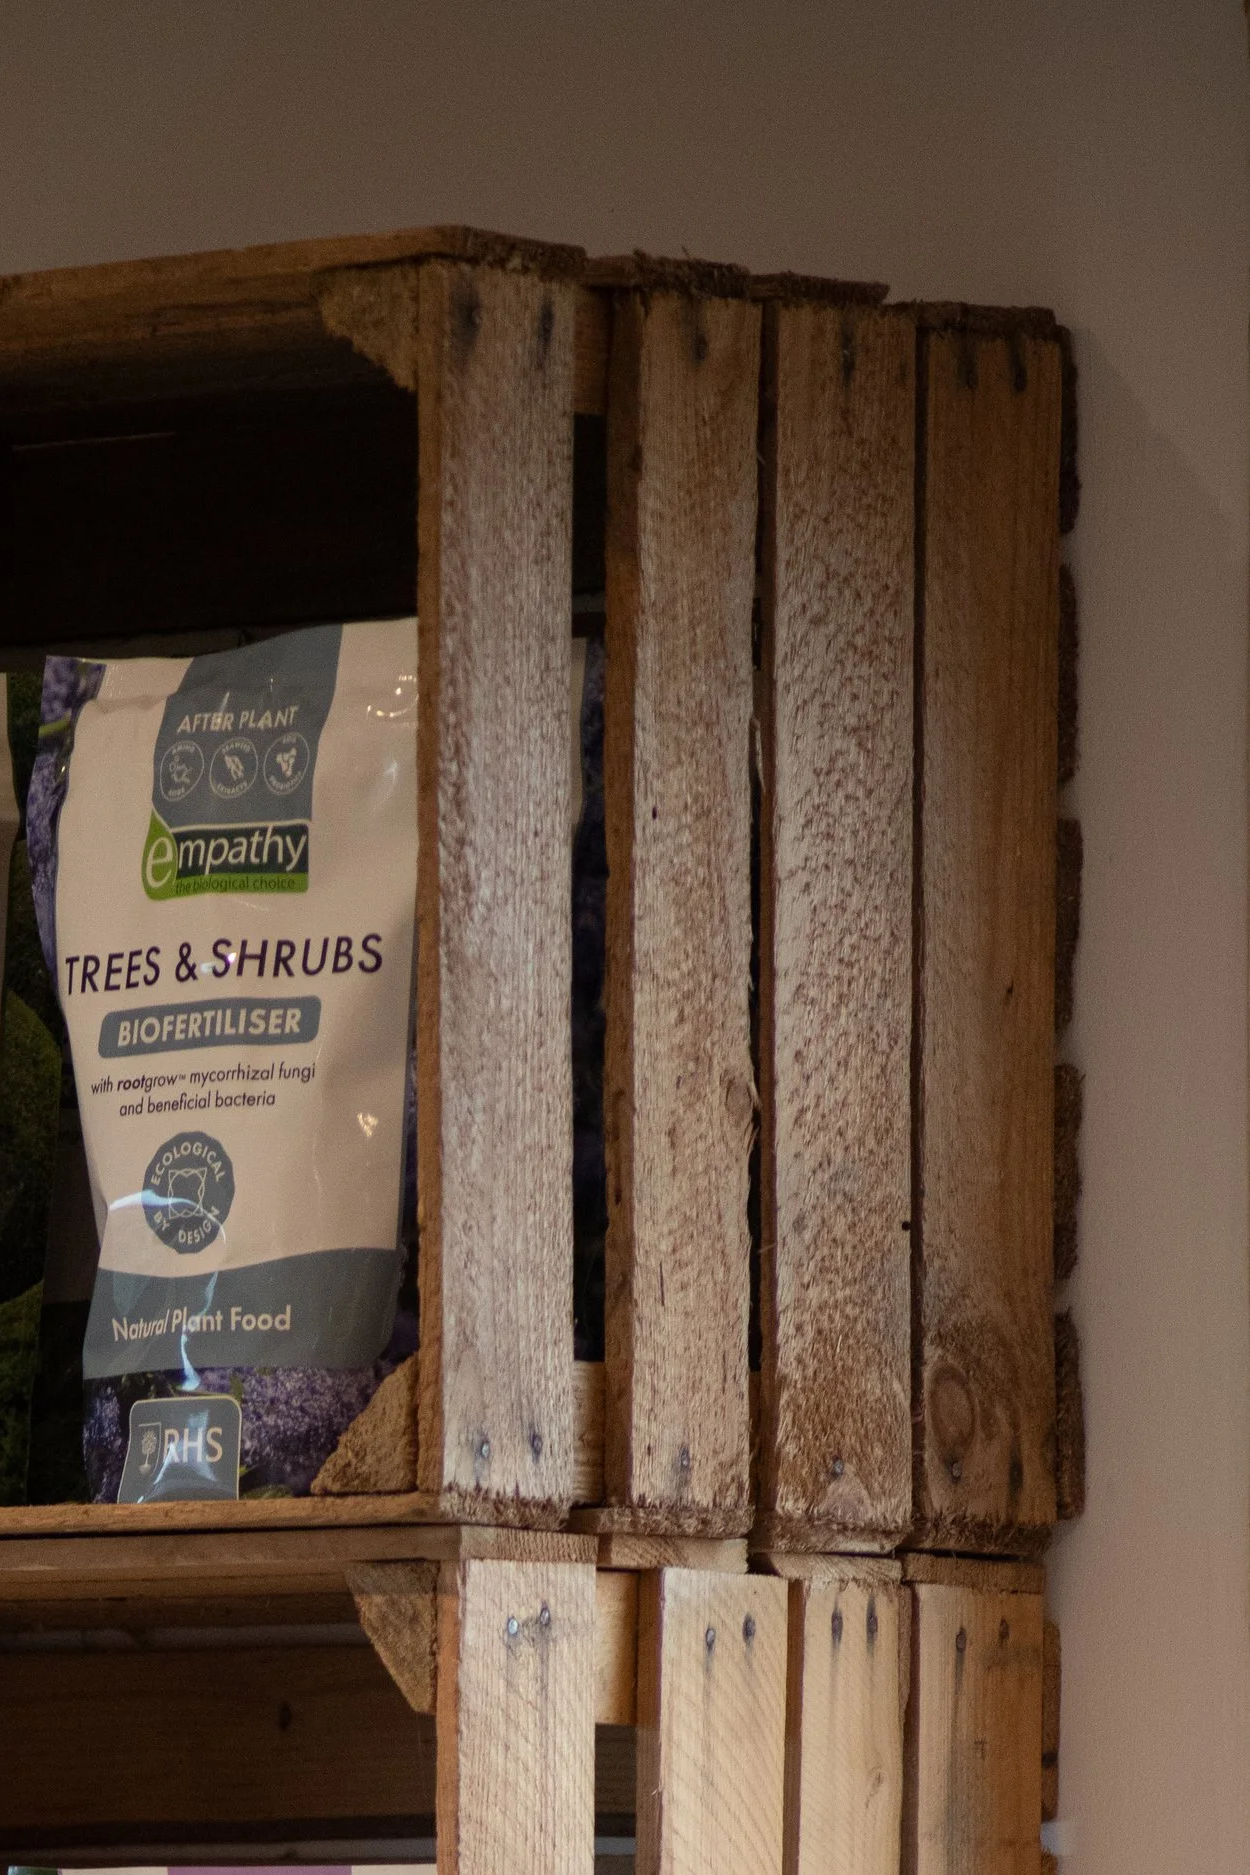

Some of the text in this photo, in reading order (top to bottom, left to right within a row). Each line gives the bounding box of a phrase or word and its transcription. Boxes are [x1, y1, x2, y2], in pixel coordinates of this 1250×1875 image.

[176, 705, 299, 734] AFTER PLANT
[145, 824, 308, 889] empathy
[176, 876, 296, 895] the biological choice
[64, 932, 383, 997] TREES & SHRUBS
[117, 1006, 302, 1049] BIOFERTILISER
[91, 1079, 114, 1095] with
[189, 1067, 275, 1091] mycorrhizal
[278, 1062, 316, 1085] fungi
[119, 1090, 276, 1117] and beneficial bacteria
[150, 1140, 226, 1186] ECOLOGICAL
[152, 1205, 221, 1245] BY DESIGN
[111, 1306, 292, 1342] Natural Plant Food
[162, 1428, 224, 1464] RHS
